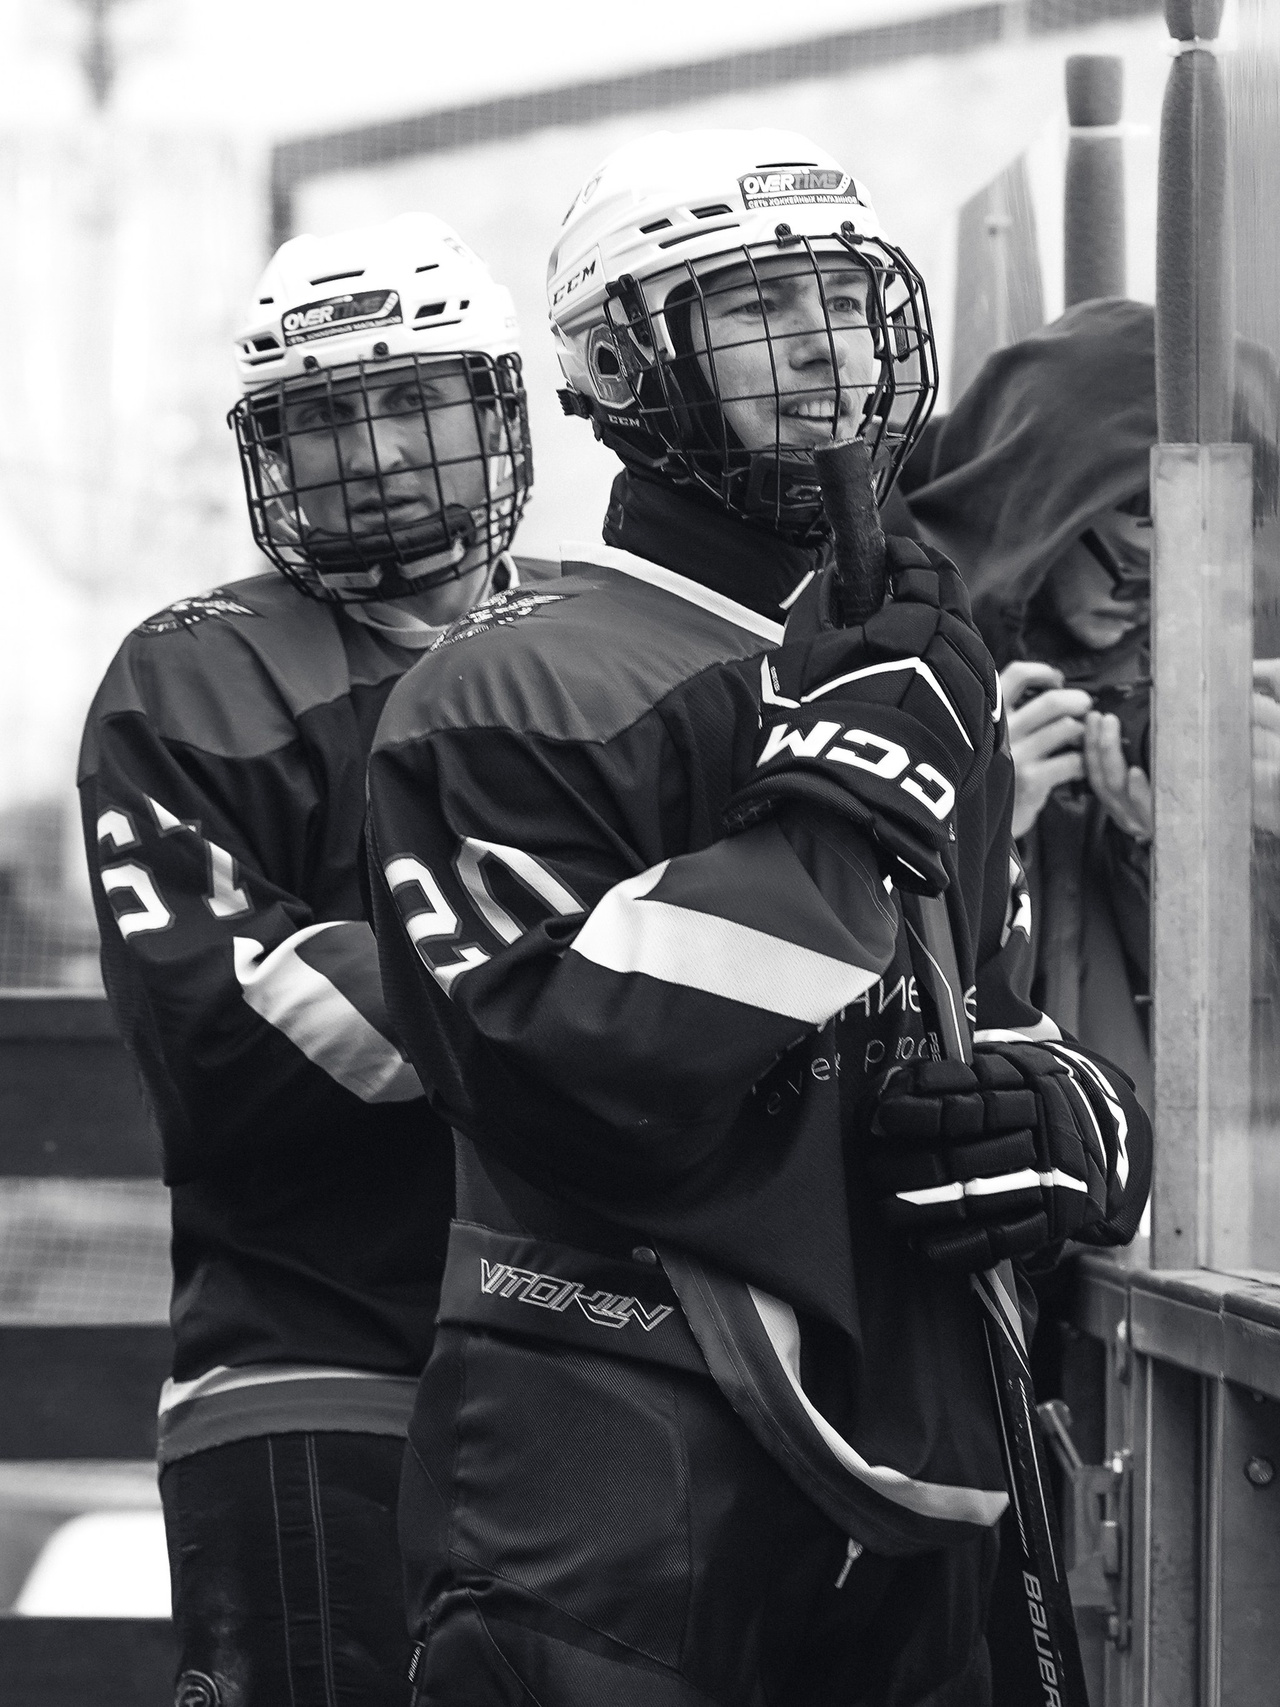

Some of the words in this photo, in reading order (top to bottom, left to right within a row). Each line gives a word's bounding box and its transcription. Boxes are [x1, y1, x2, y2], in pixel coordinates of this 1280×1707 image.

[743, 173, 838, 195] OVERTIME
[553, 260, 597, 306] CCM
[756, 721, 955, 820] CCM
[384, 835, 588, 1001] 20
